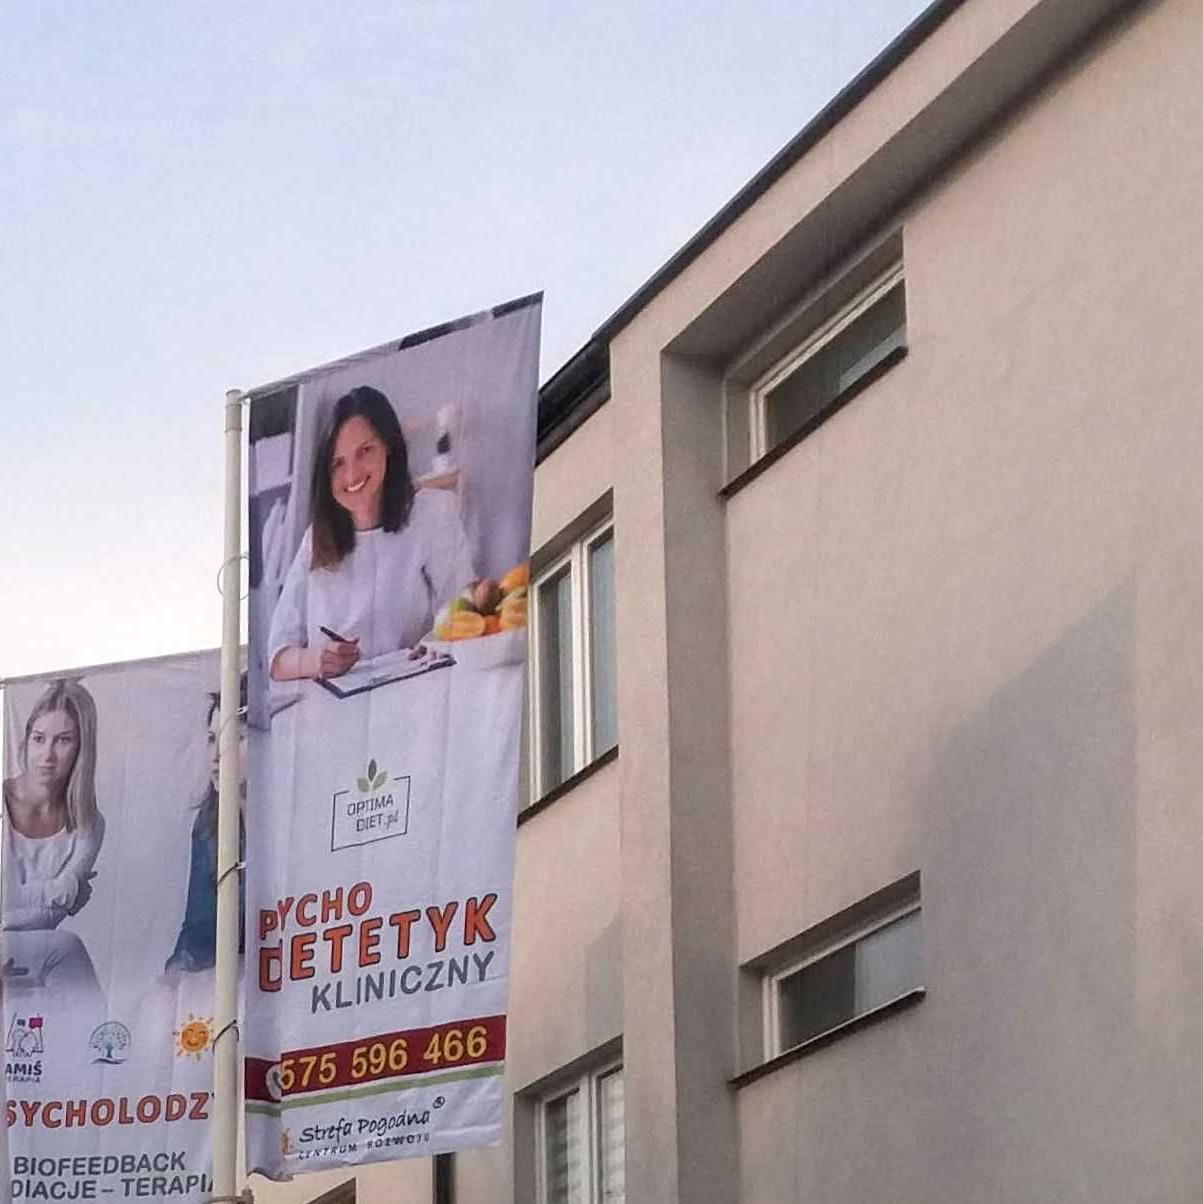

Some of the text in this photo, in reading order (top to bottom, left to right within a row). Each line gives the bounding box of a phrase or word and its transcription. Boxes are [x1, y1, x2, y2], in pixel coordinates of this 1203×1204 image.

[347, 794, 394, 816] OPTIMA
[311, 951, 494, 1014] KLINICZNY
[280, 1026, 488, 1091] 575 596 466
[5, 1092, 214, 1128] SYCHOLODZ
[299, 1109, 430, 1144] Strefa Pogodna
[13, 1151, 186, 1177] BIOFEEDBACK
[298, 1143, 358, 1160] CENTRUM
